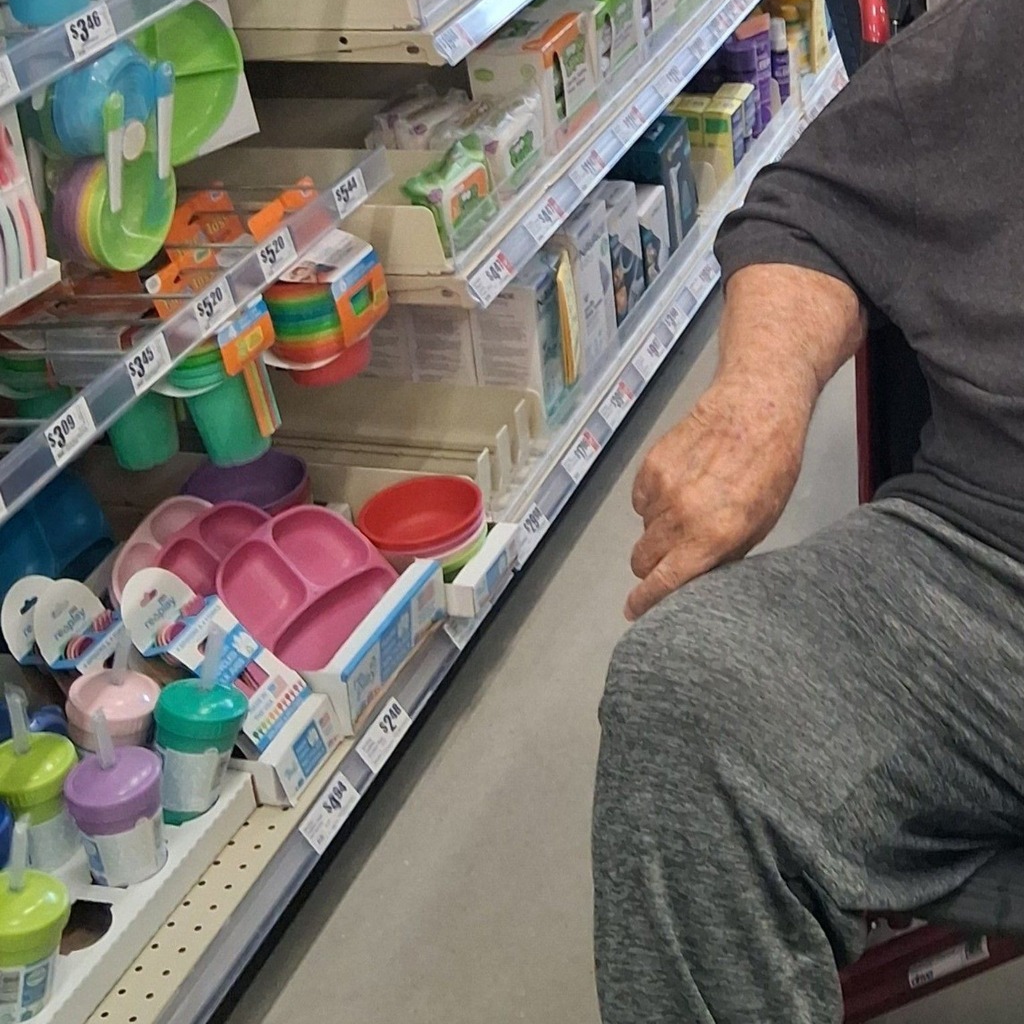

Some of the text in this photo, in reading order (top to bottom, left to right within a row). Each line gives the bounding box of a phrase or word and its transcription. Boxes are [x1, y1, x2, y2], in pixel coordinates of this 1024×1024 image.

[69, 11, 102, 42] $346
[335, 178, 358, 206] $544
[260, 235, 286, 265] $520
[196, 286, 223, 318] $520
[129, 347, 155, 379] $345
[47, 413, 77, 449] $309
[379, 702, 402, 734] $248
